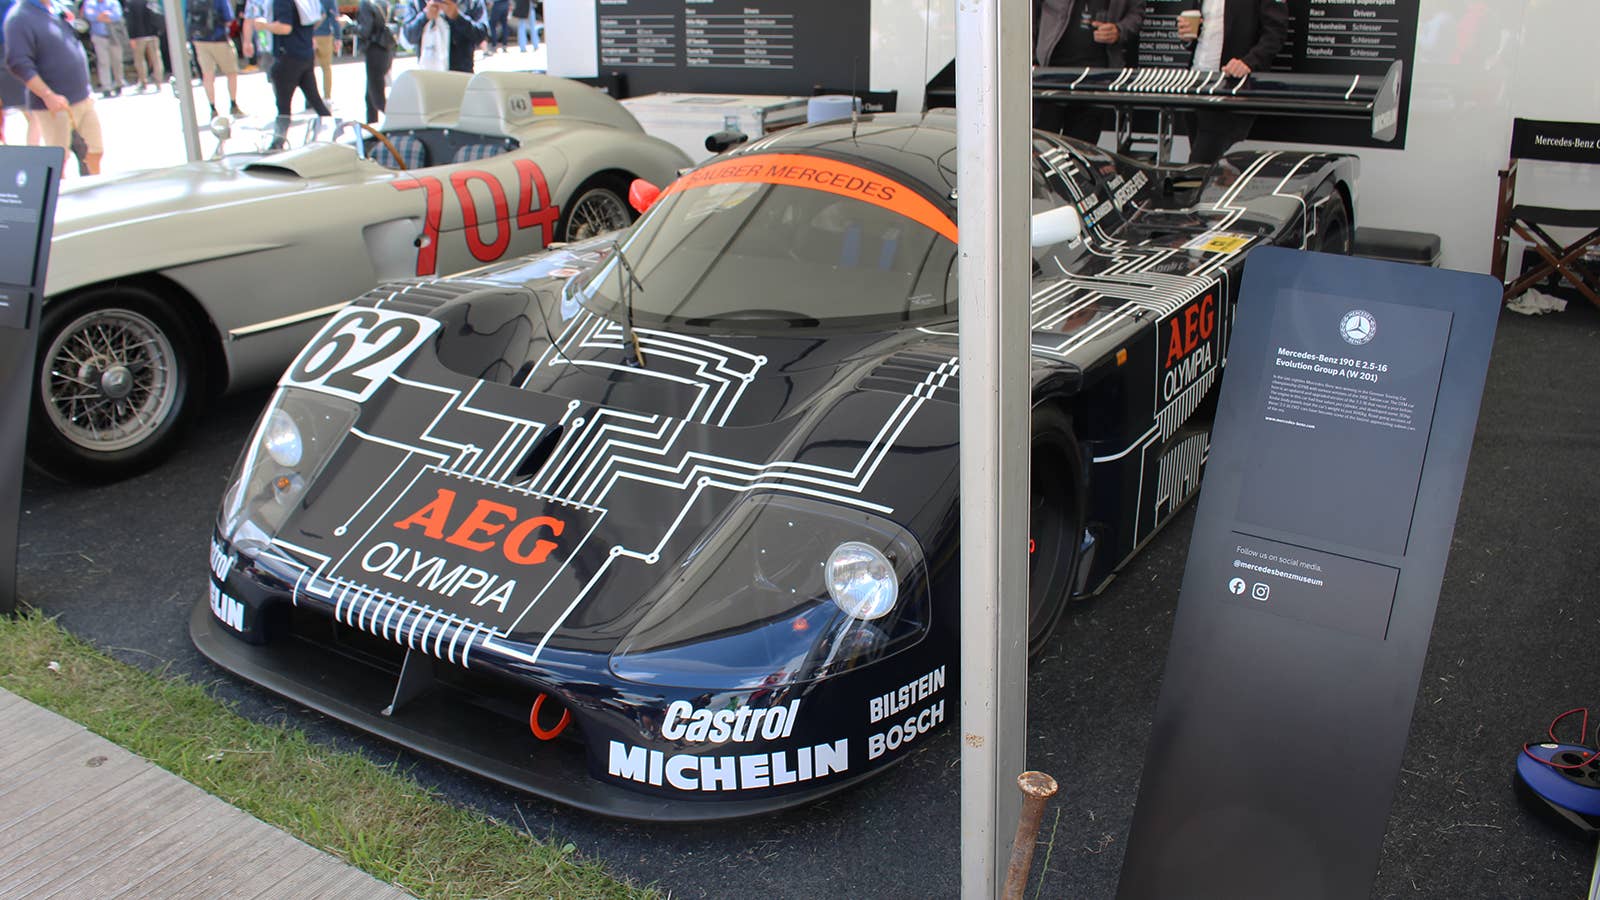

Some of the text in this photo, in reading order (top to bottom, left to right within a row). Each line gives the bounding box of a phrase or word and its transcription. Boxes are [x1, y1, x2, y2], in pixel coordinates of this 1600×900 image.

[1353, 9, 1376, 18] Drivers
[1534, 134, 1595, 149] Mercedes-Benz
[765, 165, 897, 201] MERCEDES
[391, 159, 560, 276] 704
[291, 311, 421, 395] 62
[1165, 294, 1214, 369] AEG
[1163, 341, 1212, 402] OLYMPIA
[1276, 358, 1378, 383] Evolution Group A (W 201)
[1277, 347, 1338, 364] Mercedes-Benz
[1339, 358, 1355, 368] 190
[1361, 361, 1389, 373] 2.5-16
[393, 488, 566, 566] AEG
[361, 541, 517, 613] OLYMPIA
[1233, 559, 1323, 587] @mercedesbenzmuseum
[1236, 546, 1258, 557] Follow
[1278, 556, 1299, 566] social
[1299, 562, 1322, 572] media.
[661, 698, 801, 744] Castrol
[869, 665, 946, 724] BILSTEIN
[868, 699, 945, 760] BOSCH
[608, 737, 849, 791] MICHELIN
